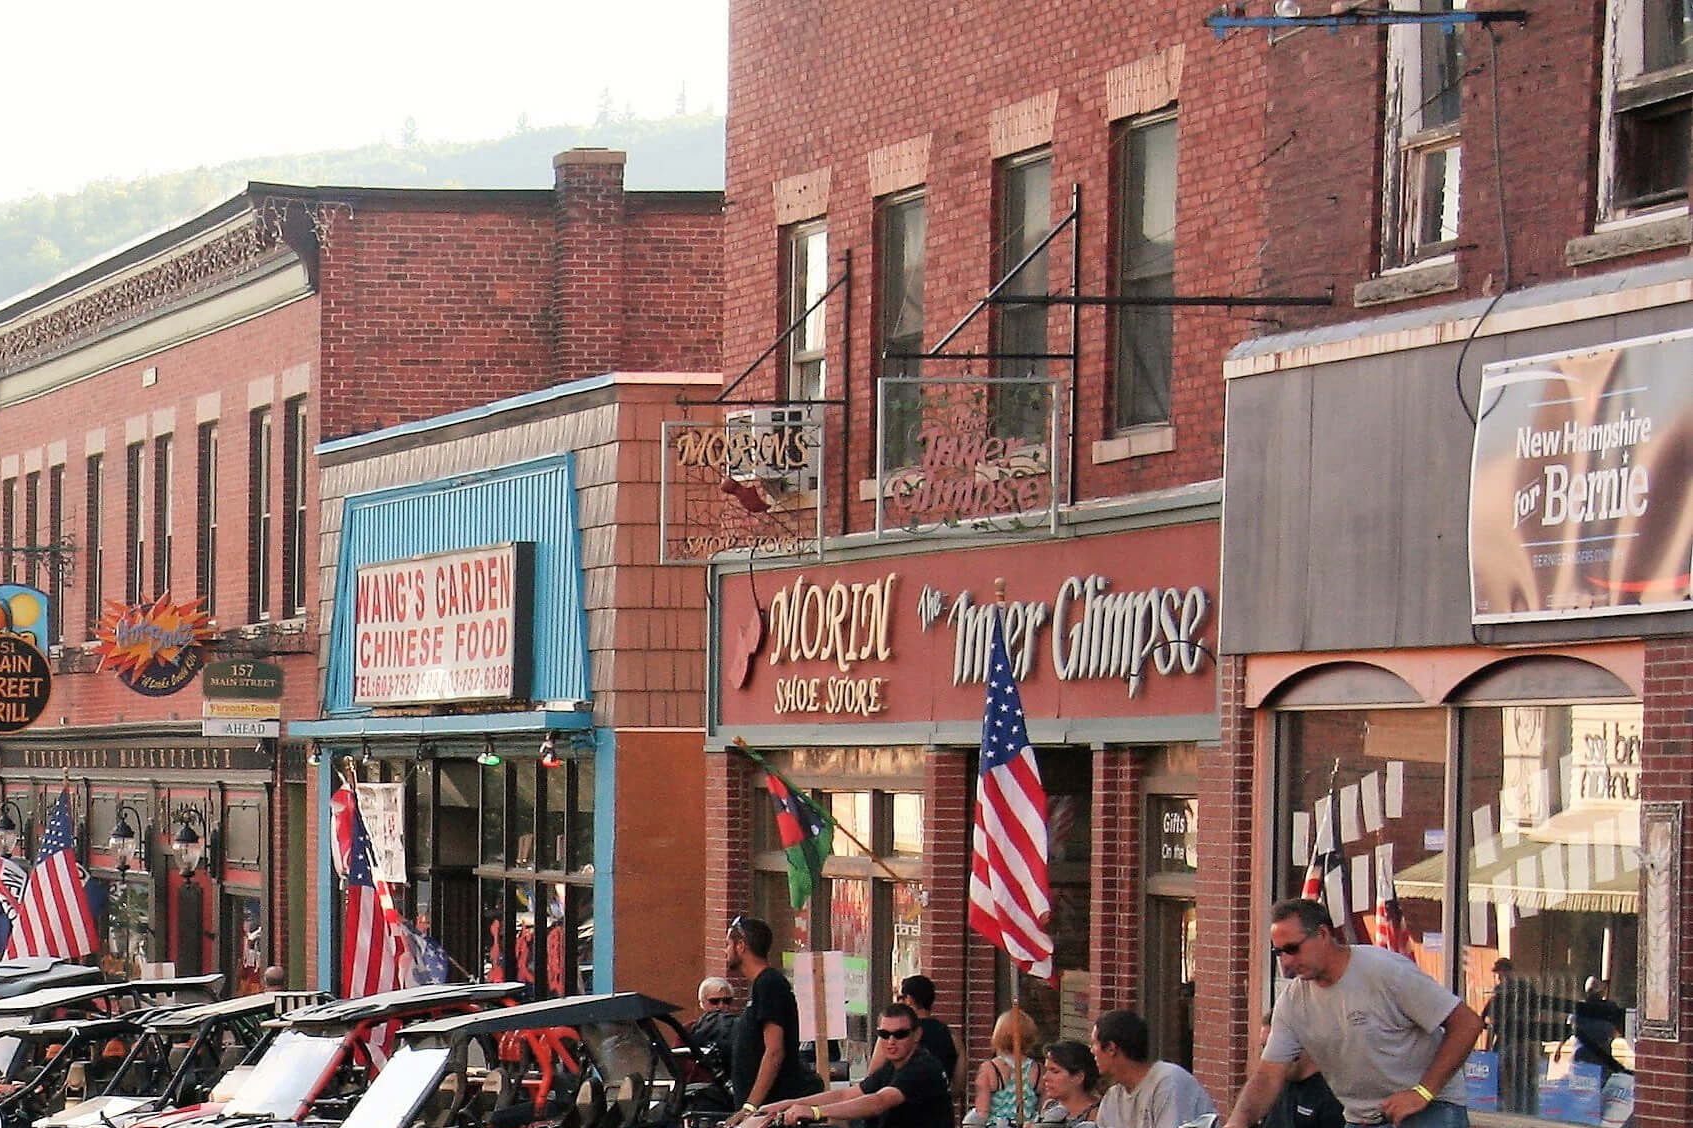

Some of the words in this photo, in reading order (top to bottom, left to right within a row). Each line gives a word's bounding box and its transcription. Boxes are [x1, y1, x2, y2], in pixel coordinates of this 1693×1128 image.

[1515, 426, 1561, 459] New
[1563, 407, 1652, 460] Hampshire
[1513, 483, 1541, 529] for
[1541, 453, 1650, 527] Bernie
[355, 568, 425, 625] WANG'S
[435, 554, 511, 619] GARDEN
[359, 626, 444, 669] CHINESE
[455, 616, 508, 662] FOOD
[769, 572, 897, 673] MORIN
[1051, 573, 1209, 700] Glimpse
[210, 677, 238, 687] MAIN
[240, 679, 276, 688] STREET
[231, 664, 254, 678] 157
[773, 674, 821, 715] SHOE
[825, 674, 884, 717] STORE
[225, 723, 266, 735] AHEAD
[1163, 812, 1185, 834] Gifts
